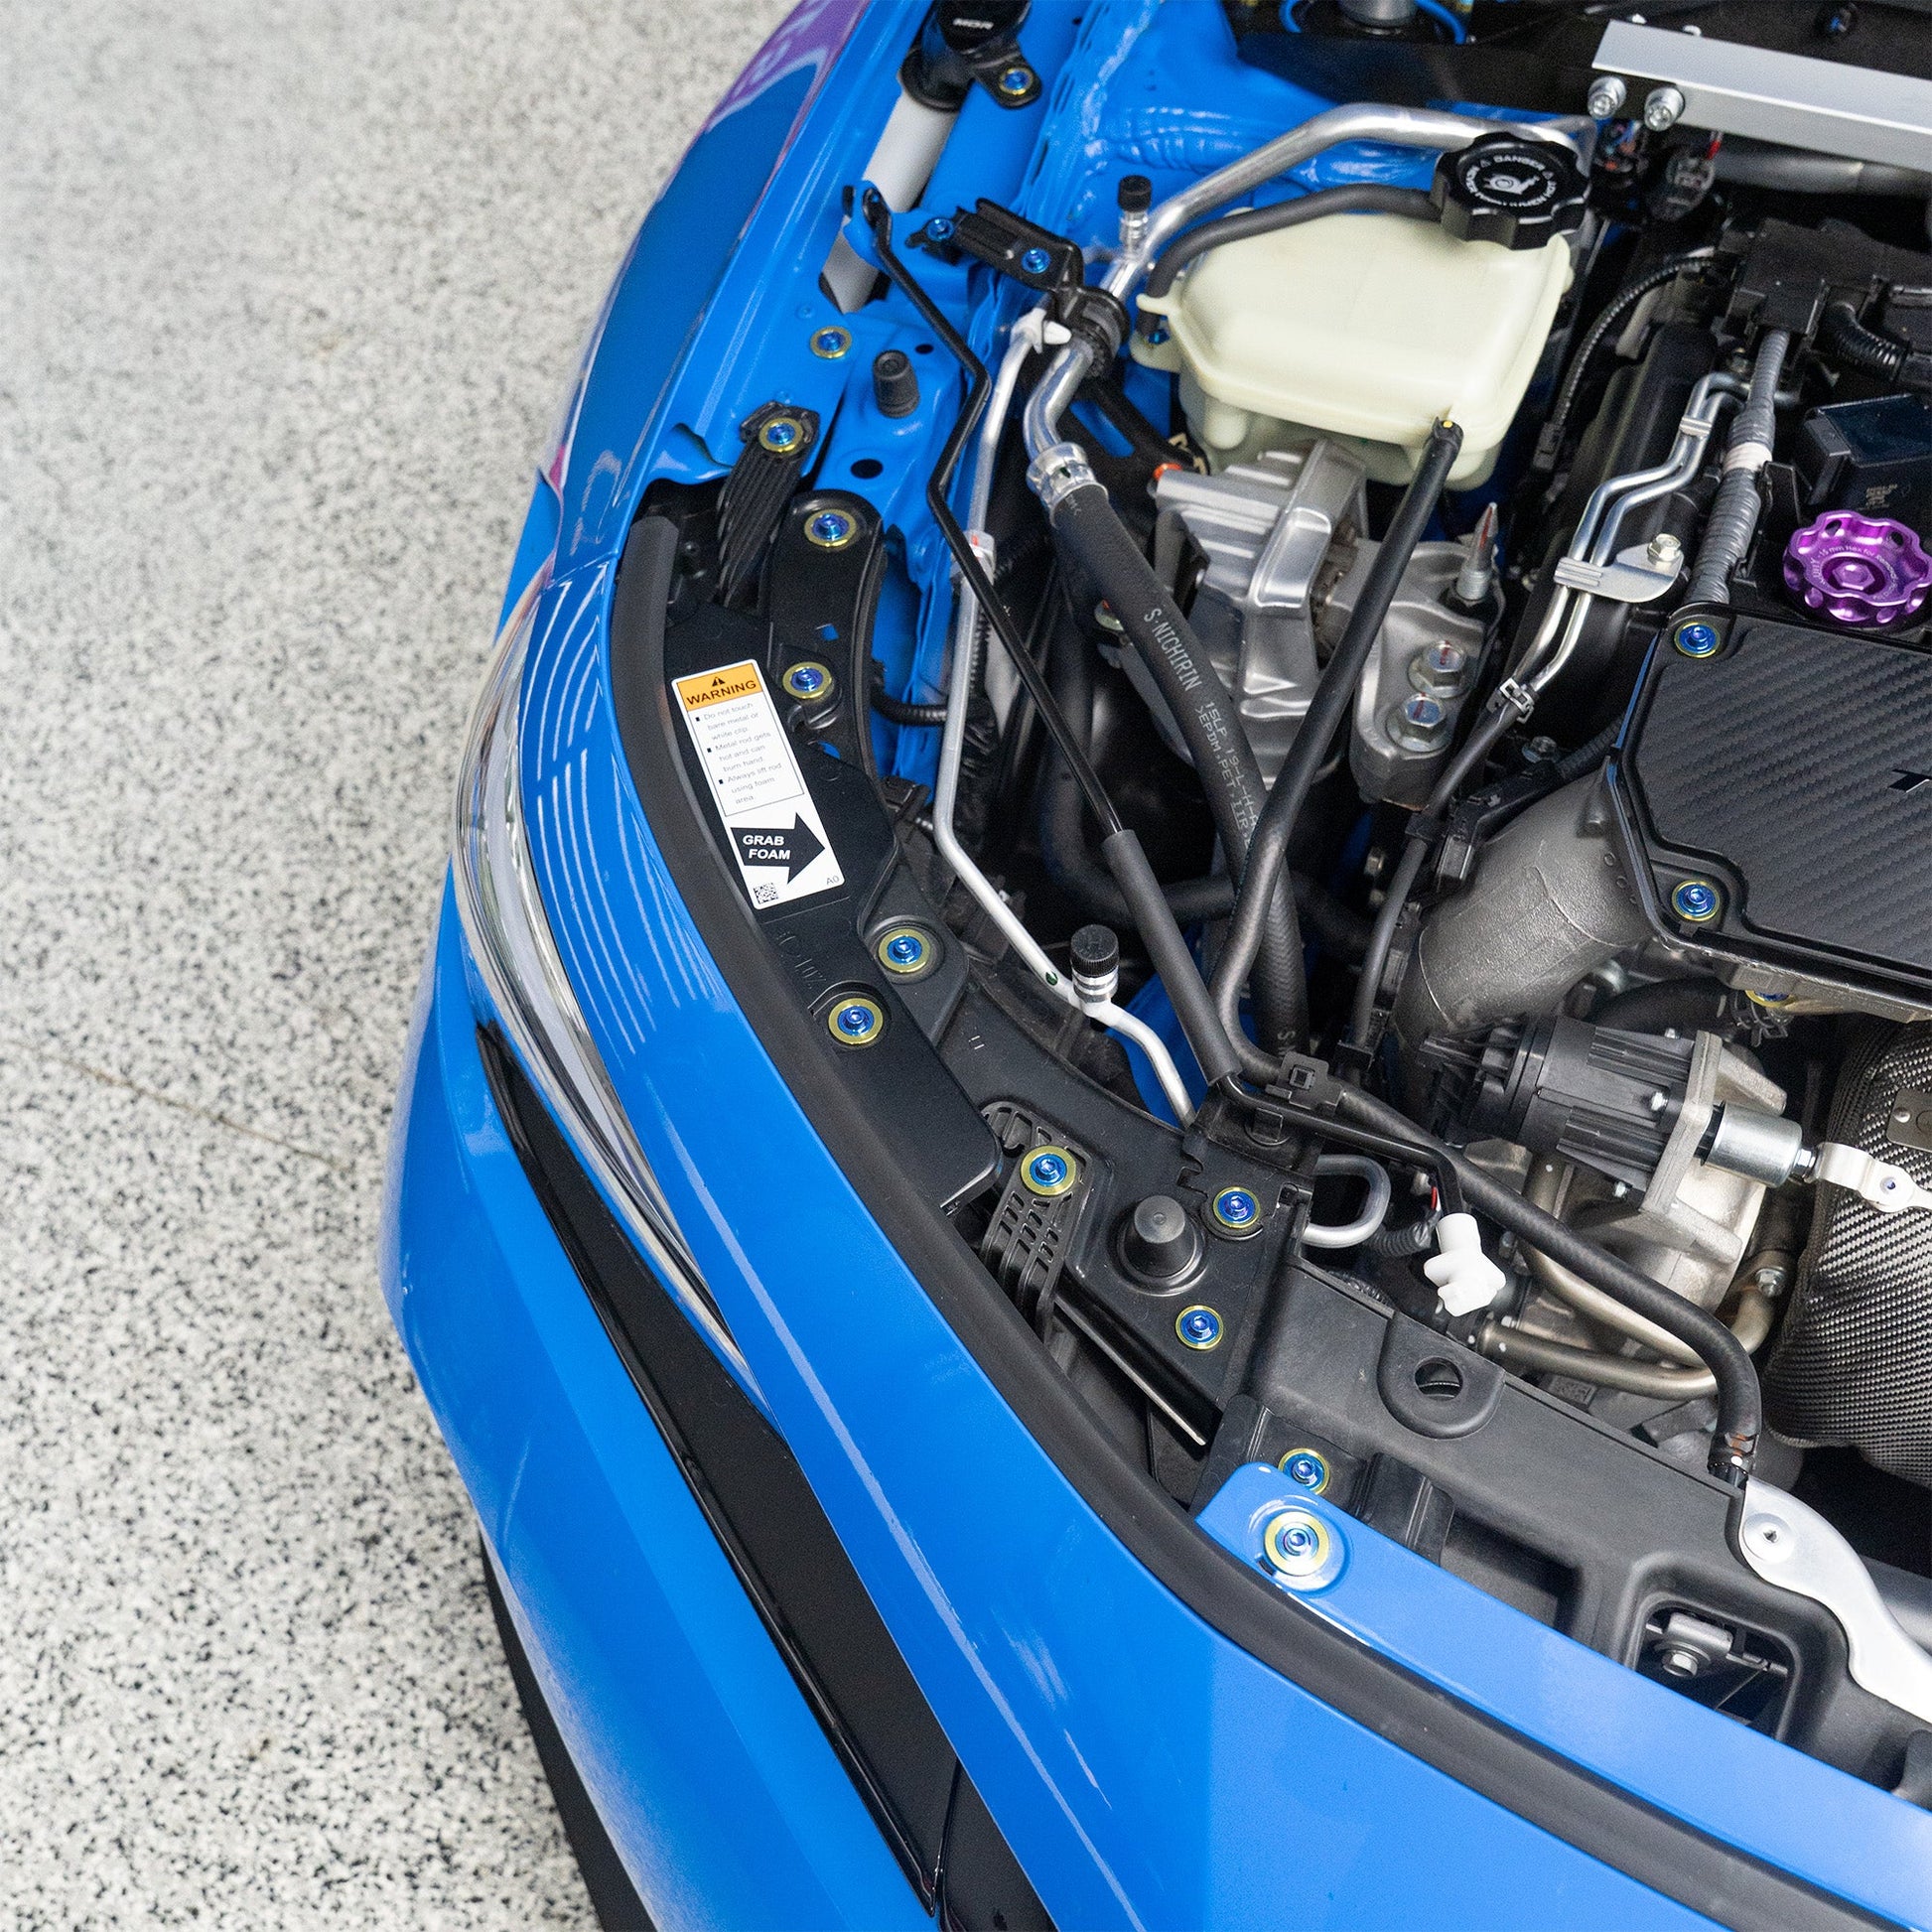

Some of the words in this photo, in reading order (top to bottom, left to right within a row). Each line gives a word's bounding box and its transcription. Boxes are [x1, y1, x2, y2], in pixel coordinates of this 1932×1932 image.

[686, 680, 757, 705] WARNING
[703, 711, 717, 721] Do
[718, 707, 731, 716] not
[732, 701, 755, 713] touch
[707, 720, 727, 731] bare
[727, 714, 750, 726] metal
[712, 729, 733, 740] white
[715, 739, 739, 751] Metal
[739, 735, 753, 746] rod
[754, 730, 772, 742] gets
[719, 752, 733, 761] hot
[734, 748, 751, 759] and
[751, 744, 766, 754] can
[723, 761, 742, 772] burn
[727, 769, 757, 783] Always
[758, 764, 768, 774] lift
[768, 761, 783, 771] rod
[732, 781, 755, 793] using
[755, 775, 776, 787] foam
[742, 835, 784, 846] GRAB
[748, 848, 791, 860] FOAM
